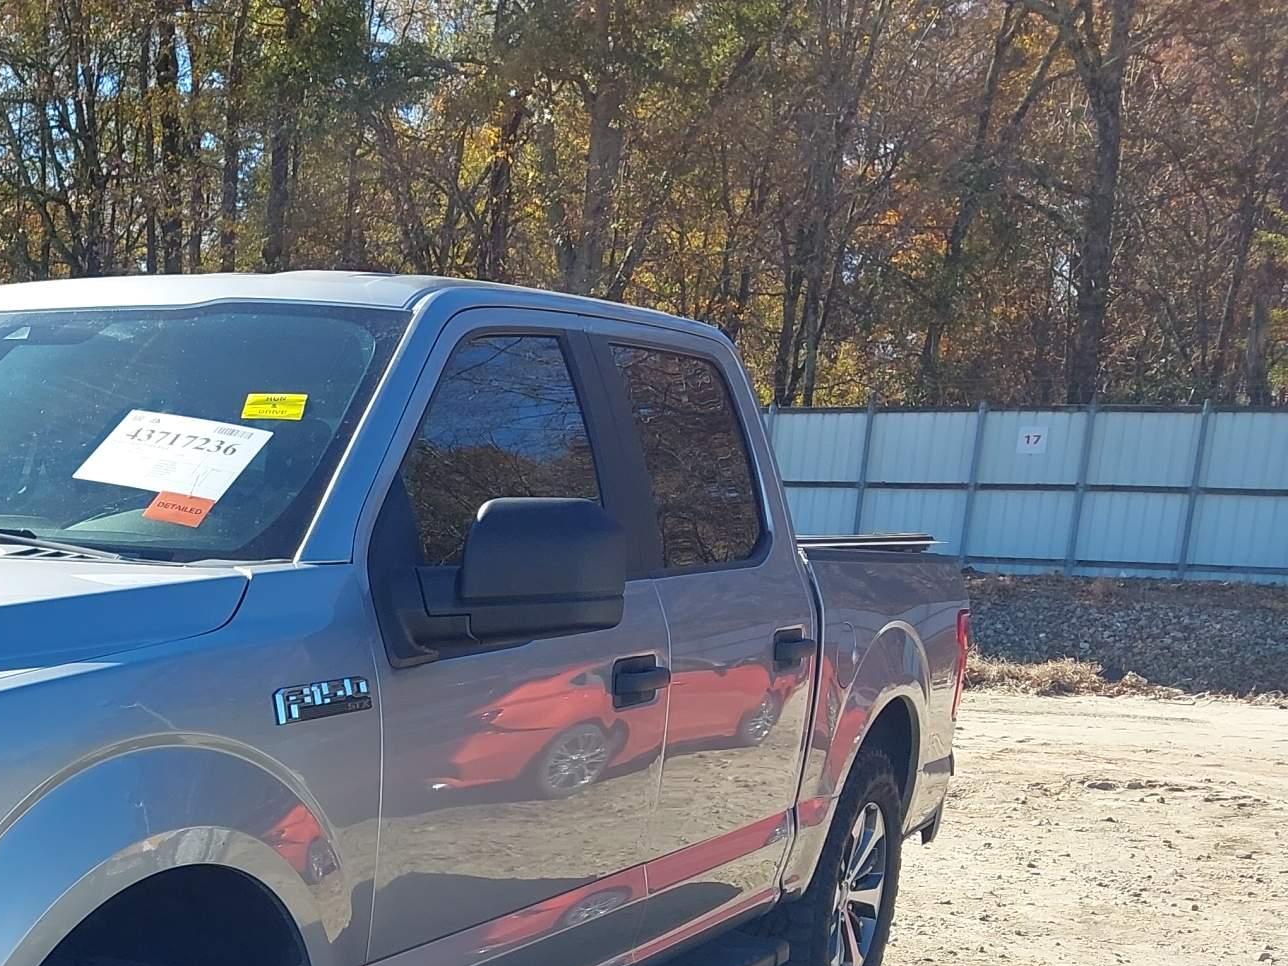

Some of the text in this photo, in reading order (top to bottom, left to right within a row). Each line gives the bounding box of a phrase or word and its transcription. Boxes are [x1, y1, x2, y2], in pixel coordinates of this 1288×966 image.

[126, 427, 241, 456] 43717236
[1024, 434, 1042, 445] 17
[156, 501, 203, 515] DETAILED
